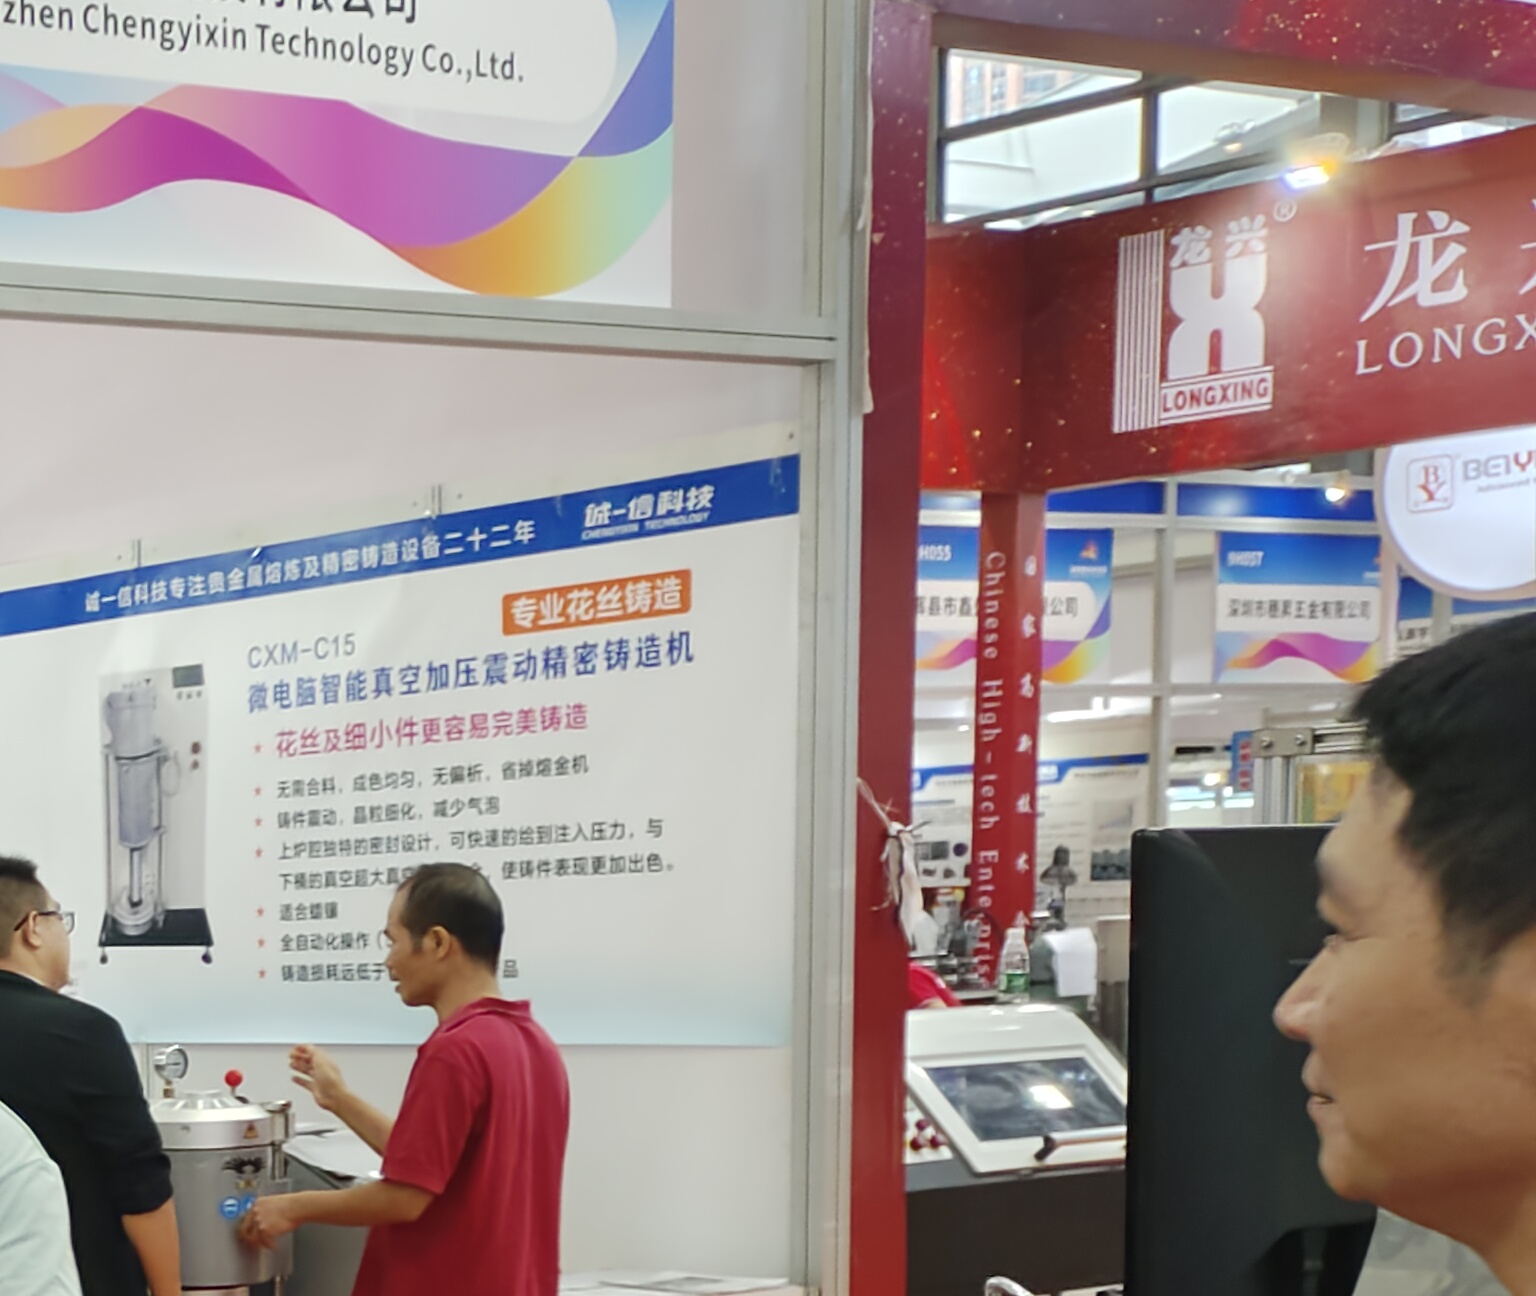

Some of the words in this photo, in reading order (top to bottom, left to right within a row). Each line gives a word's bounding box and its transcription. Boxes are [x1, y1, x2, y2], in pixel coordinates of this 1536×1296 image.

[83, 4, 246, 51] Chengyixin
[255, 24, 415, 76] Technology
[422, 44, 523, 84] Co.,Ltd.
[1359, 210, 1471, 322] 龙
[1162, 378, 1269, 412] LONGXING
[1463, 449, 1536, 481] BEIY
[511, 575, 683, 628] 专业花丝铸造
[247, 632, 356, 669] CXM-C15
[248, 630, 695, 714] 微电脑智能真空加压震动精密铸造机
[275, 702, 589, 758] 花丝及细小件更容易完美铸造
